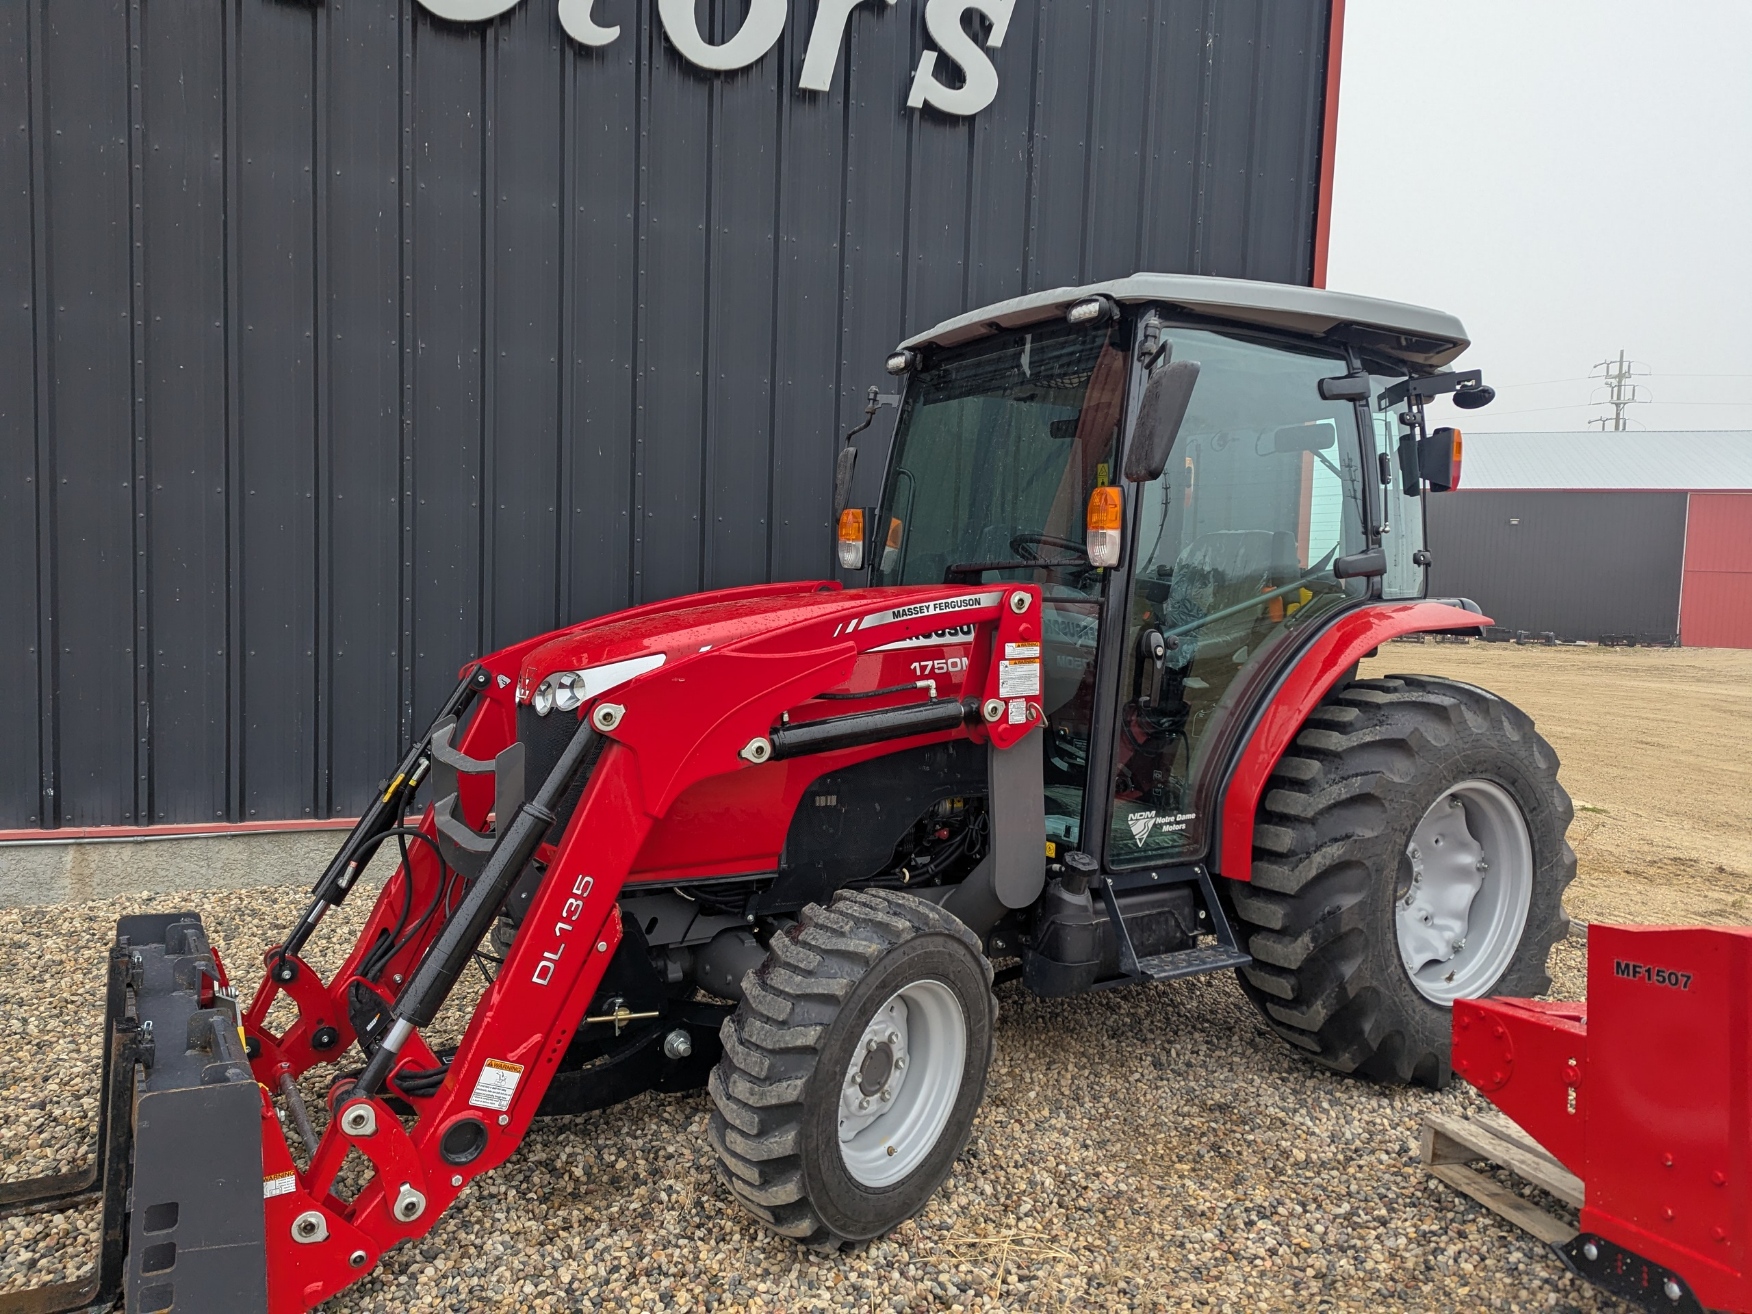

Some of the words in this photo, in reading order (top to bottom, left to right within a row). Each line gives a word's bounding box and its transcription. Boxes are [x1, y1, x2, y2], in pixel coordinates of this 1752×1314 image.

[892, 604, 931, 620] MASSEY
[933, 598, 981, 612] FERGUSON
[1128, 811, 1156, 820] NDM
[1156, 816, 1175, 824] Notre
[1176, 813, 1196, 821] Dame
[1162, 823, 1186, 832] Motors
[532, 943, 566, 986] DL
[555, 874, 594, 937] 135
[1614, 959, 1692, 990] MF1507
